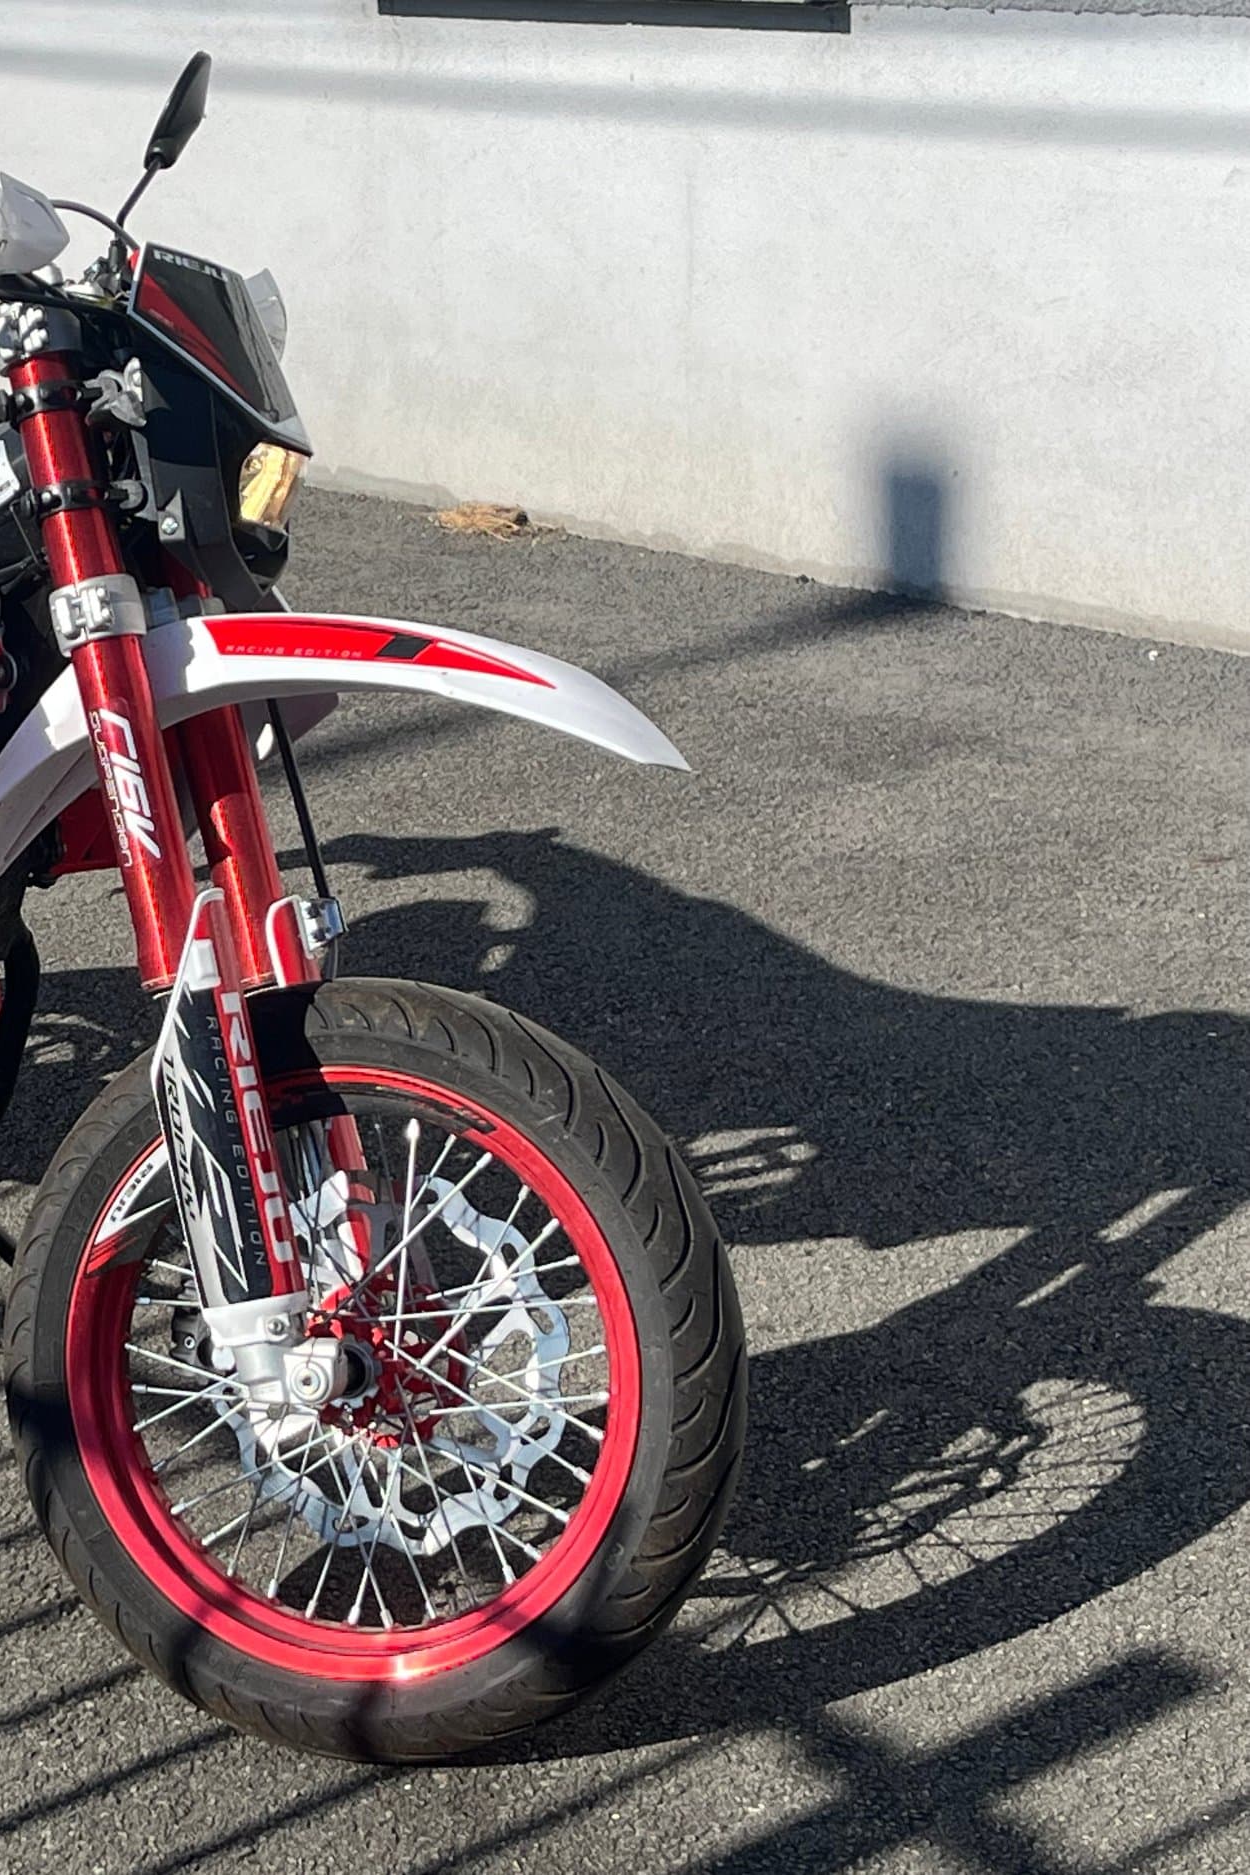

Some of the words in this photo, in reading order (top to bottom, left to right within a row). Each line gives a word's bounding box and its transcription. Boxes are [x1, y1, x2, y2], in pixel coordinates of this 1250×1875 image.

[152, 249, 229, 282] RIEJU
[225, 644, 285, 655] RACING
[293, 647, 362, 658] EDITION
[163, 1055, 196, 1221] TROPHY
[205, 1015, 239, 1124] RACING
[232, 1143, 267, 1266] EDITION
[220, 991, 294, 1263] RIEJU
